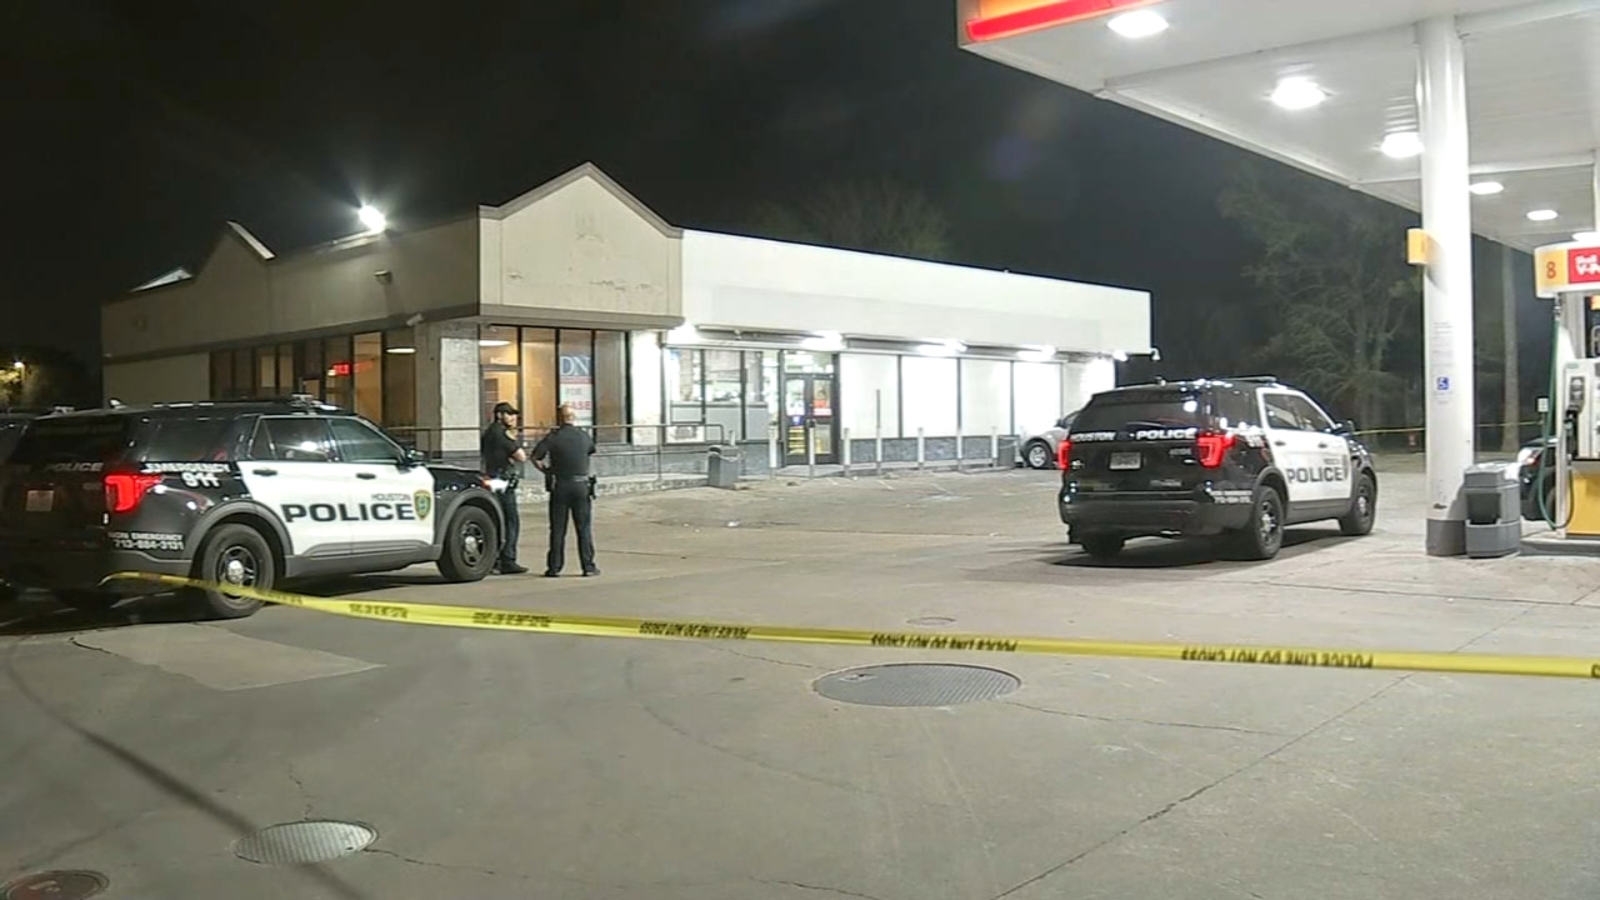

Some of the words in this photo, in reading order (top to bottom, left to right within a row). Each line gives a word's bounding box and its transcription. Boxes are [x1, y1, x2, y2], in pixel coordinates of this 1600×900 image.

[1546, 261, 1556, 279] 8
[1135, 428, 1196, 440] POLICE
[141, 463, 231, 474] EMERGENCY
[1286, 467, 1342, 483] POLICE
[181, 473, 220, 487] 911
[370, 493, 411, 502] HOUSTON
[280, 503, 416, 522] POLICE
[131, 532, 183, 542] EMERGENCY
[1182, 648, 1226, 662] CROSS
[1231, 649, 1257, 664] NOT
[1259, 650, 1282, 665] DO
[1286, 651, 1317, 667] LINE
[1322, 653, 1374, 668] POLICE
